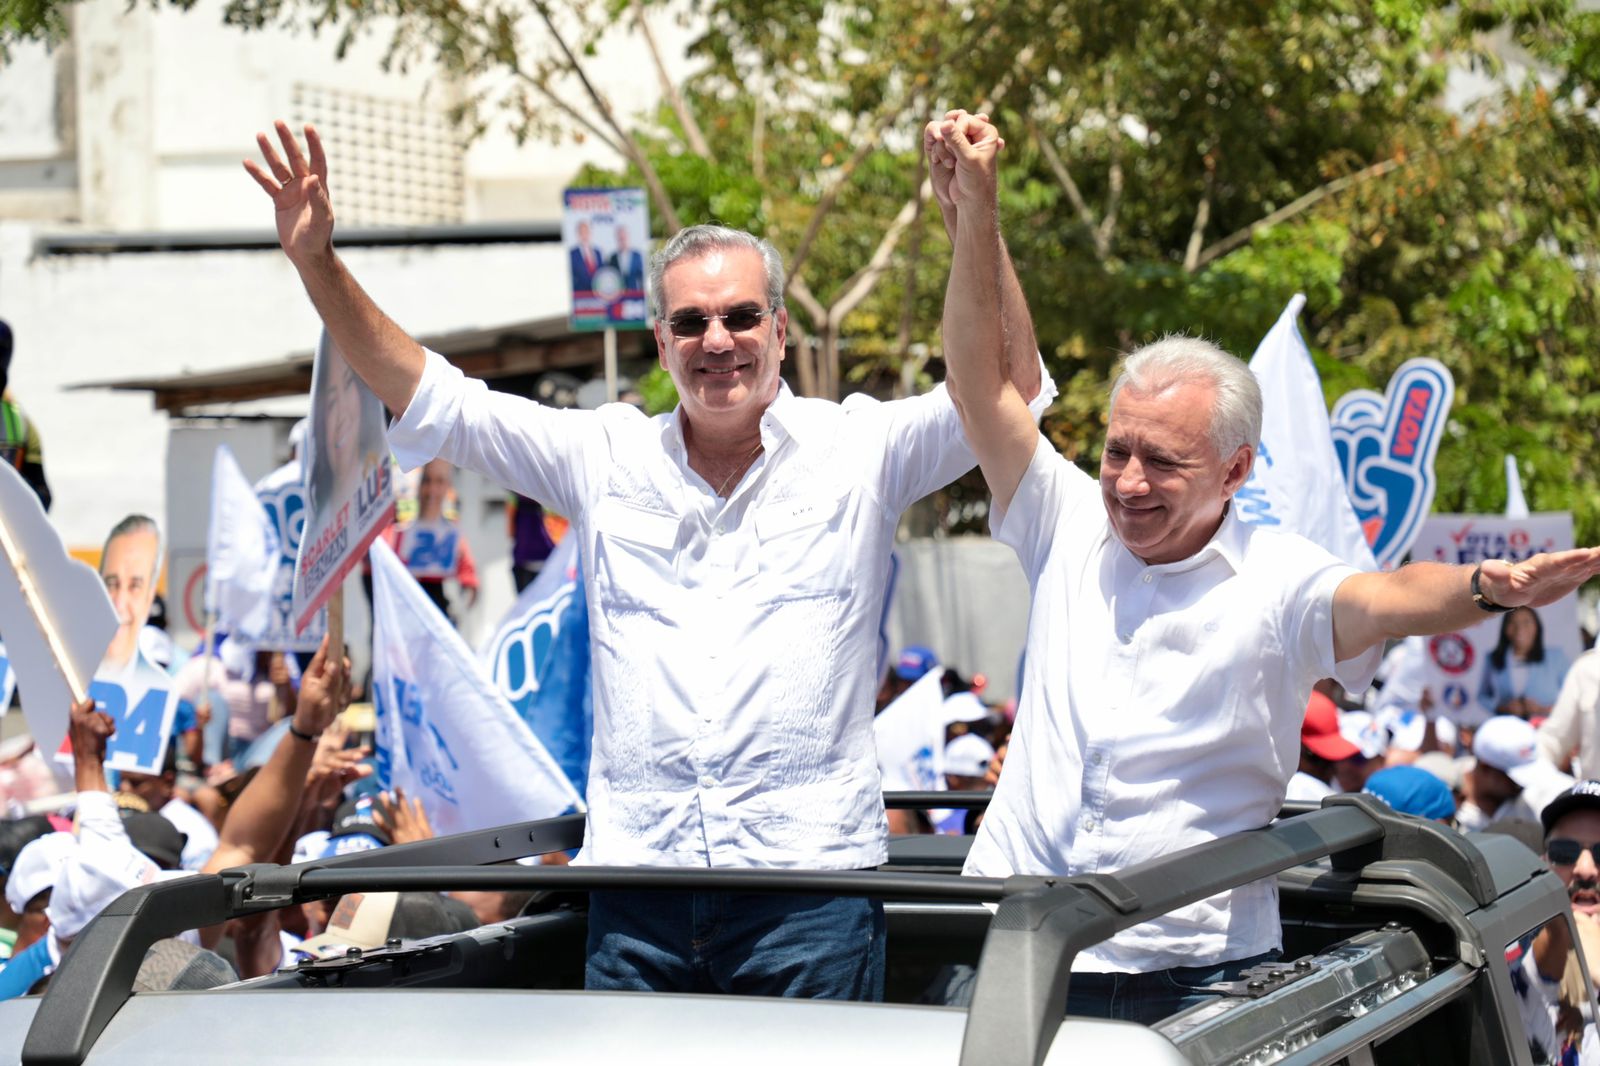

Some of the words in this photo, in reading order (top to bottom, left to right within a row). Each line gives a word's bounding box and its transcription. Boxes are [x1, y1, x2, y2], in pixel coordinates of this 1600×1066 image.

[1392, 387, 1431, 456] VOTA
[356, 455, 391, 518] LUIS
[301, 501, 350, 576] SCARLET
